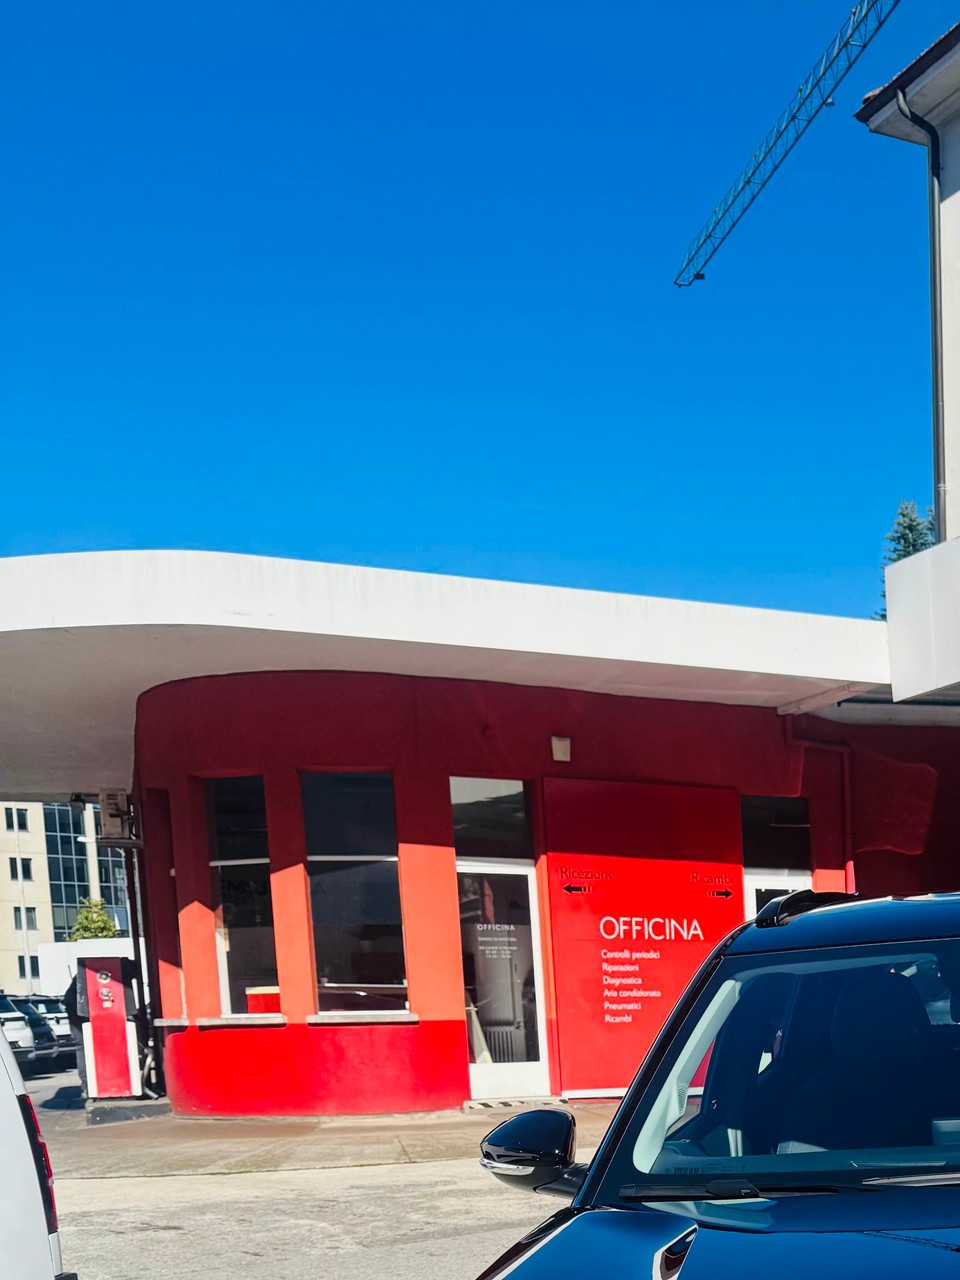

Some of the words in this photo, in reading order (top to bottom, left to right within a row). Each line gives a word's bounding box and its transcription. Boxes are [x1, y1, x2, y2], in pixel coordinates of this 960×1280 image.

[560, 866, 615, 879] Ricezione
[599, 916, 704, 940] OFFICINA
[601, 949, 630, 959] Controlli
[631, 950, 660, 960] periodici
[602, 963, 639, 972] Riparazioni
[602, 975, 642, 986] Diagnostica
[603, 988, 618, 997] Aria
[619, 988, 661, 997] condizionata
[604, 1001, 641, 1010] Pneumatici
[604, 1014, 632, 1022] Ricambi
